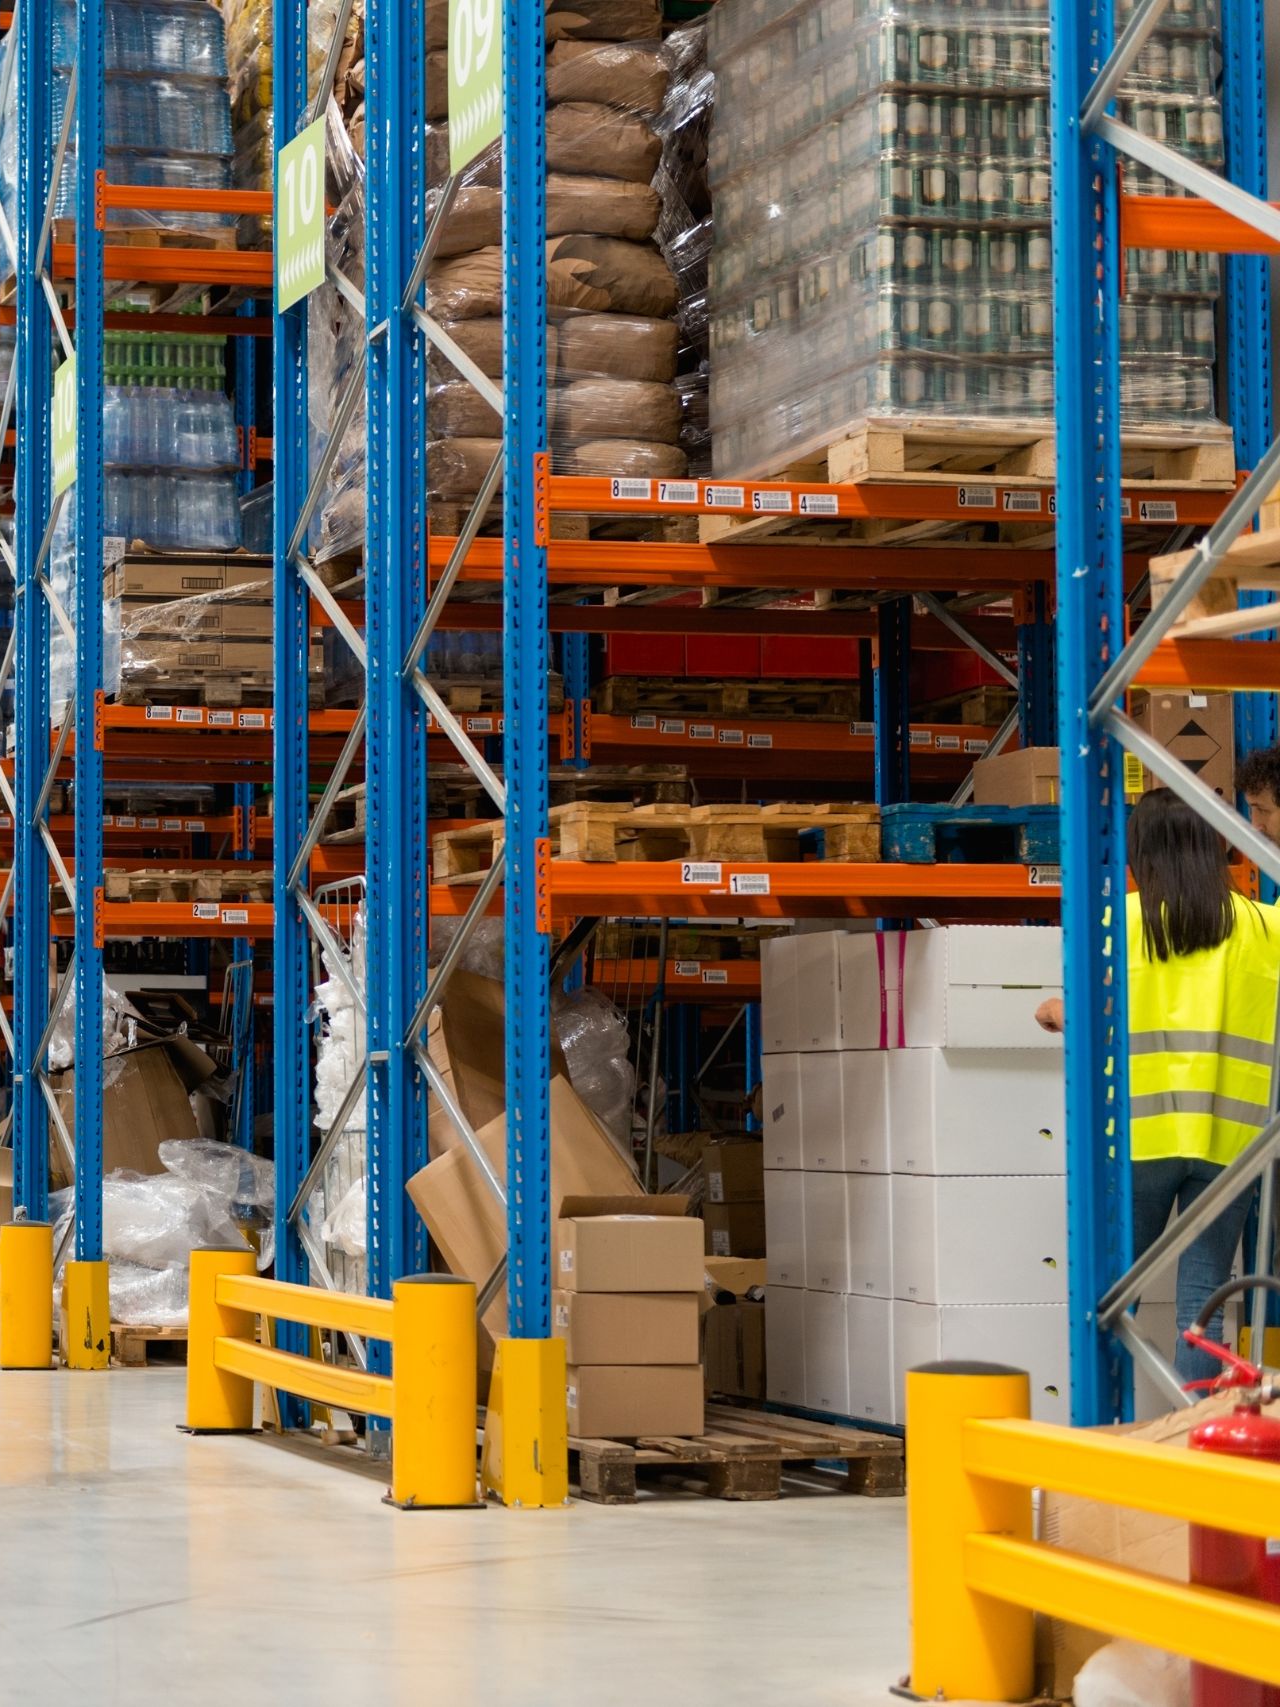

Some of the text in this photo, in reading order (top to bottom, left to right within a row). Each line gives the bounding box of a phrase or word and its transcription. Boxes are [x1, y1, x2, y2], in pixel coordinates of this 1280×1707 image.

[454, 0, 496, 87] 09
[284, 144, 317, 237] 10
[57, 370, 74, 440] 10
[612, 479, 620, 497] 8
[660, 483, 667, 500] 7
[706, 487, 713, 505] 6
[754, 492, 761, 509] 5
[959, 488, 966, 505] 8
[1004, 492, 1011, 509] 7
[800, 496, 808, 512] 4
[1049, 496, 1056, 513] 6
[1140, 503, 1147, 519] 4
[146, 705, 151, 718] 8
[177, 709, 182, 720] 7
[208, 713, 213, 723] 6
[240, 715, 245, 726] 5
[631, 715, 636, 727] 8
[661, 721, 666, 732] 7
[690, 726, 695, 737] 6
[720, 731, 724, 742] 5
[748, 736, 753, 746] 4
[936, 737, 941, 748] 5
[965, 741, 969, 751] 4
[683, 864, 691, 881] 2
[1030, 867, 1038, 884] 2
[732, 875, 738, 893] 1
[193, 904, 199, 916] 2
[222, 911, 227, 922] 1
[675, 962, 680, 974] 2
[703, 971, 707, 982] 1
